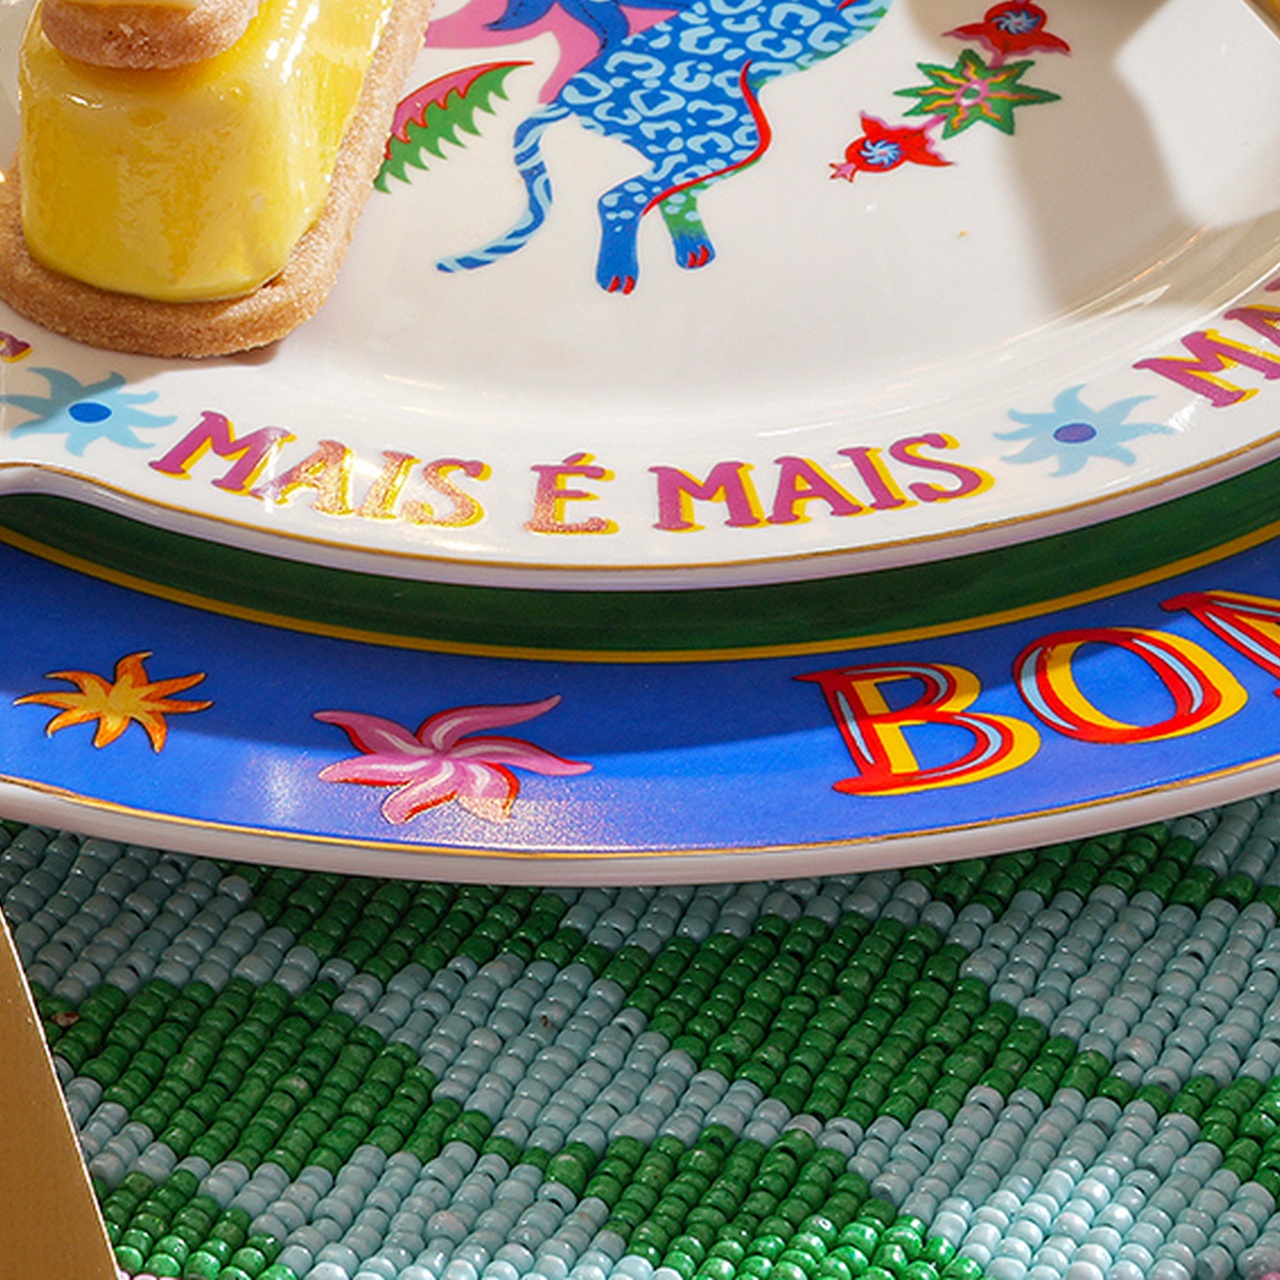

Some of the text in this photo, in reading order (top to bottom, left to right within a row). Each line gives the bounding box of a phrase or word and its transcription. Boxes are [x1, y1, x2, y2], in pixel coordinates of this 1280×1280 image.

[148, 407, 997, 536] MAIS É MAIS
